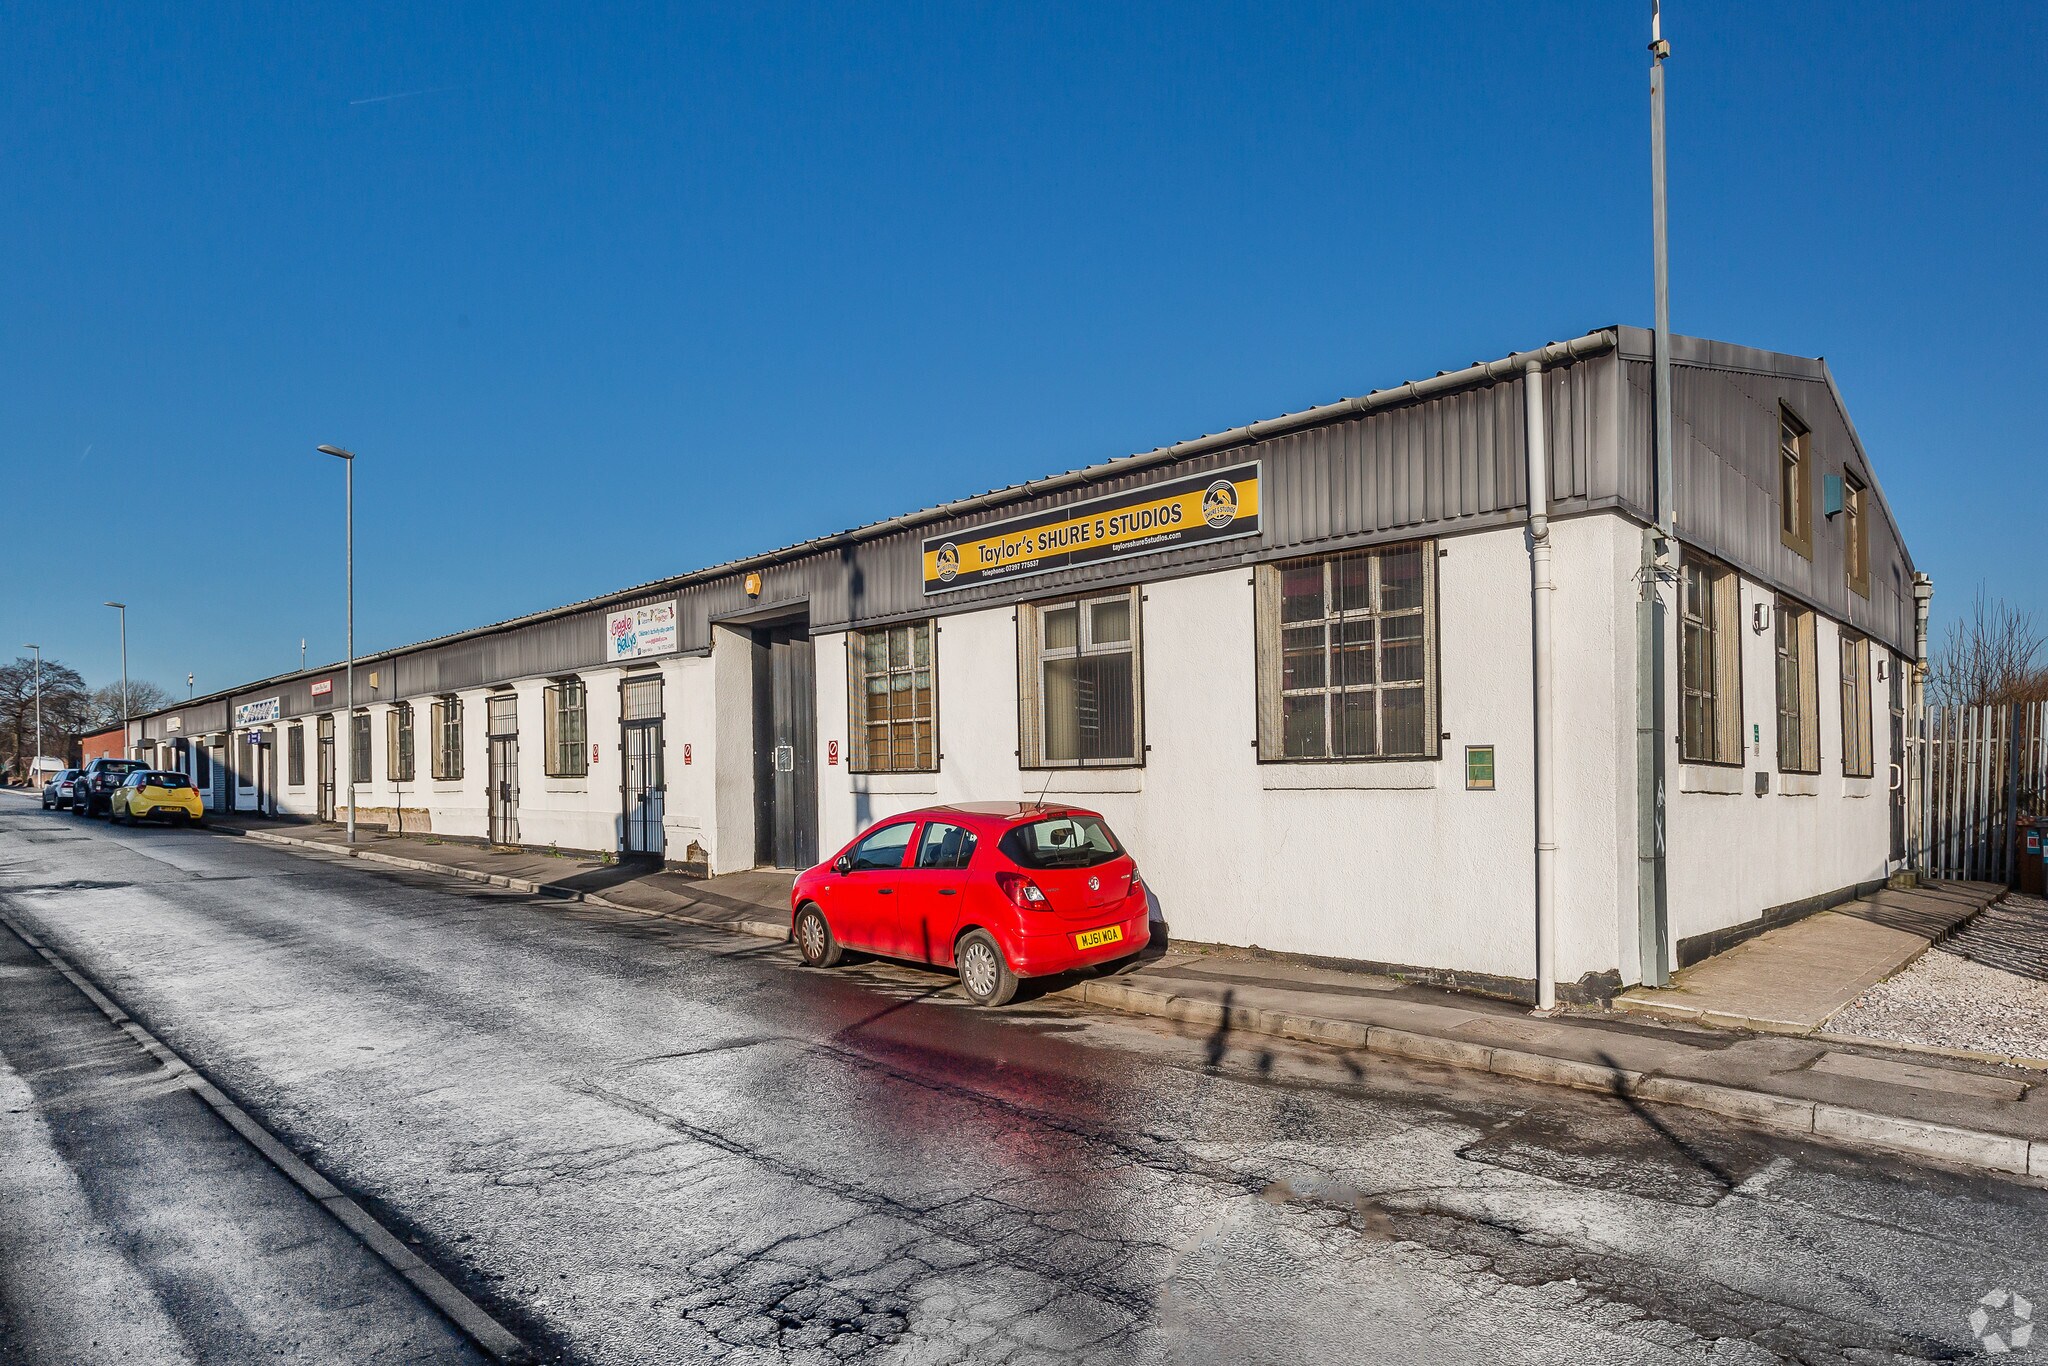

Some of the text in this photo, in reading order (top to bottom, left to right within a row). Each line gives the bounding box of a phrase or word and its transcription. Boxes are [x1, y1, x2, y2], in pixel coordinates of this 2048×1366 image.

[978, 535, 1034, 565] Taylor's
[1038, 523, 1090, 551] SHURE
[1095, 519, 1105, 539] 5
[1111, 505, 1183, 536] STUDIOS
[1112, 533, 1182, 551] taylorsshure5studios.com
[981, 567, 1005, 577] Telephone:
[611, 617, 632, 637] Giggle
[1081, 932, 1102, 946] MJ61
